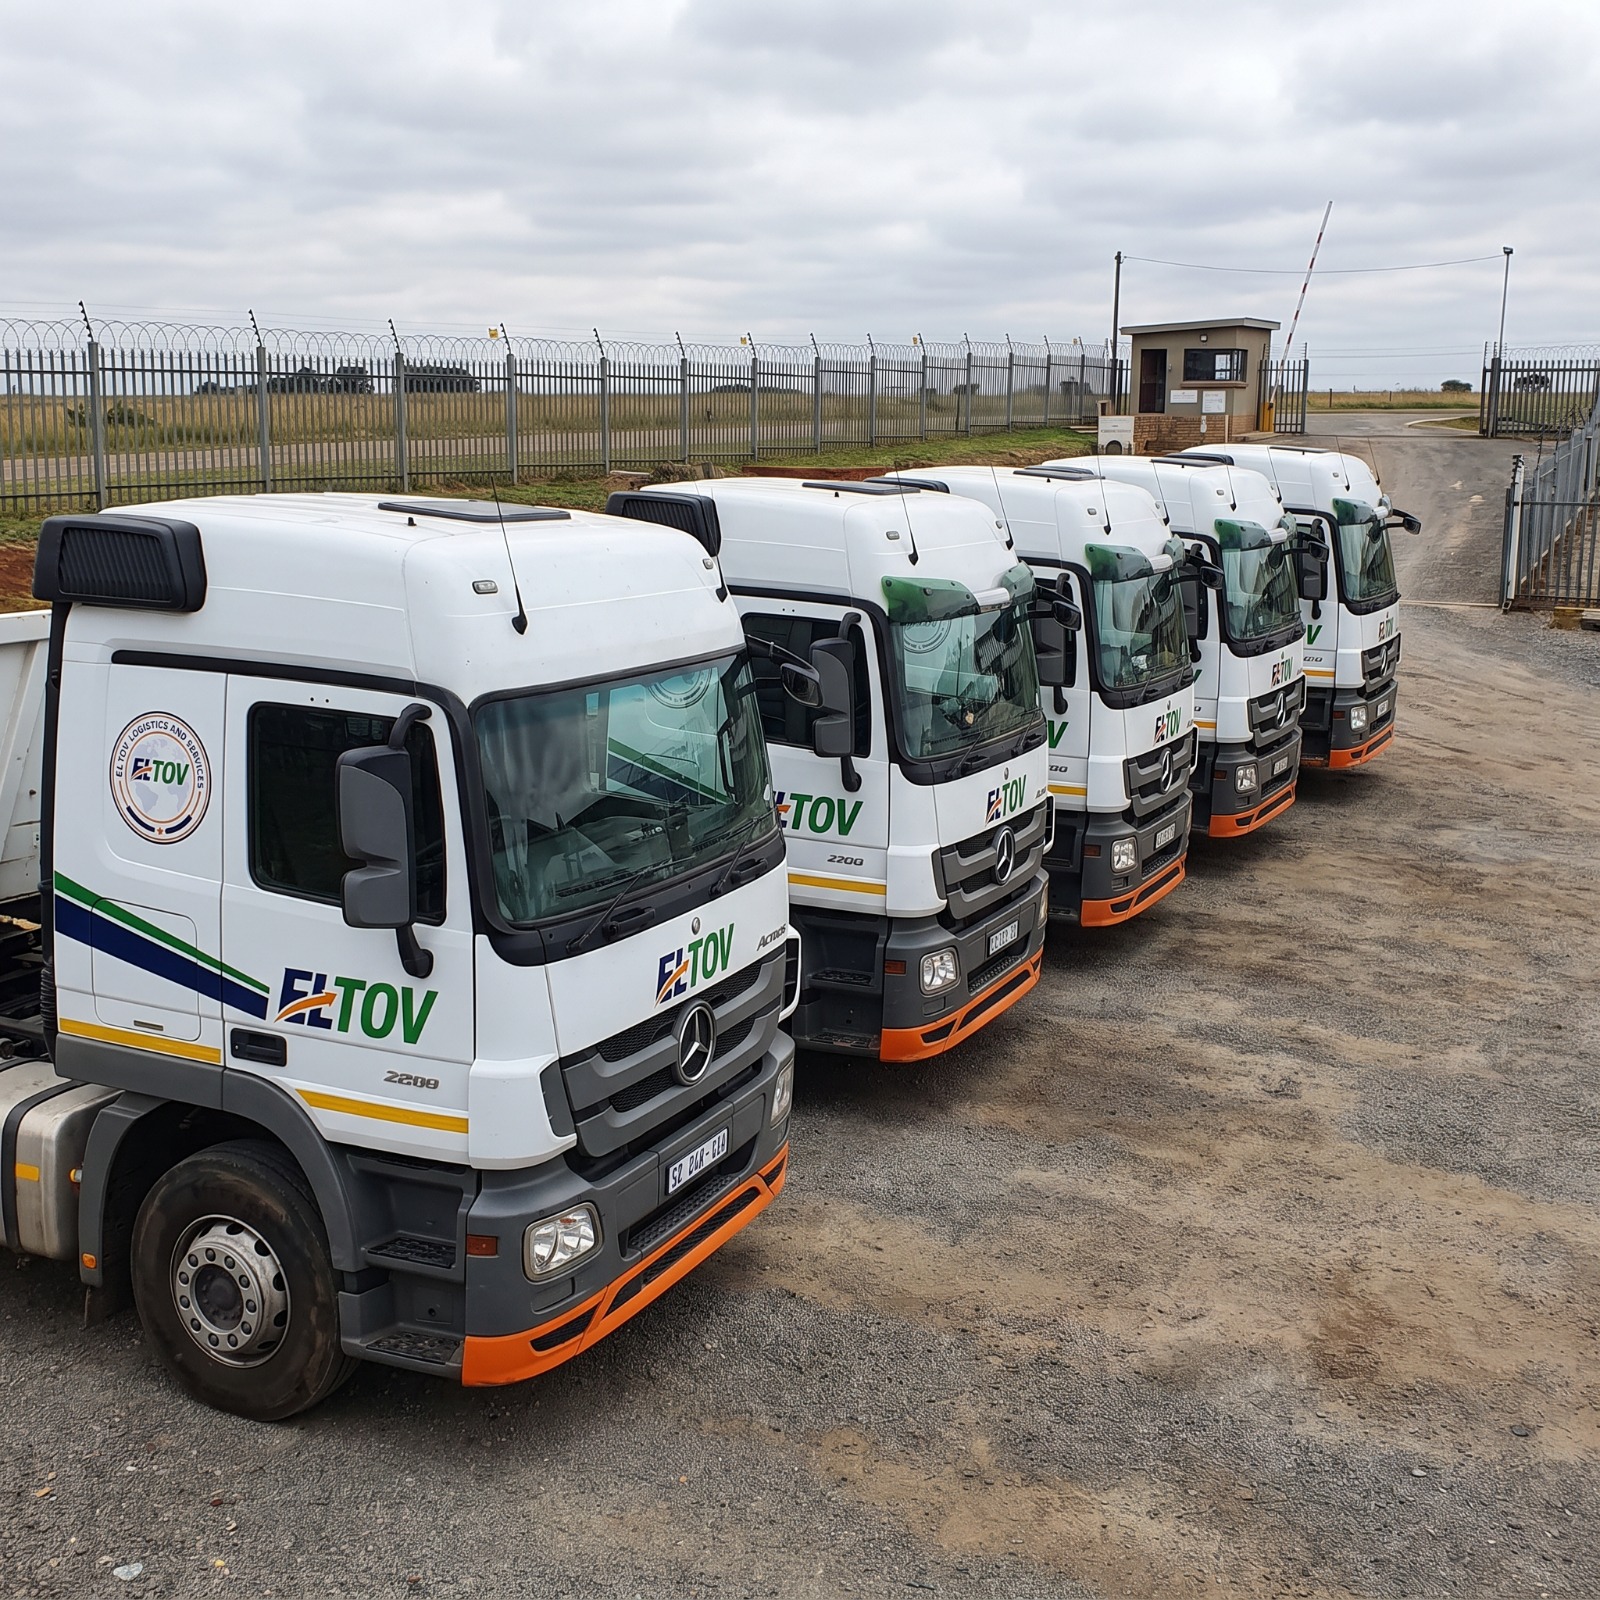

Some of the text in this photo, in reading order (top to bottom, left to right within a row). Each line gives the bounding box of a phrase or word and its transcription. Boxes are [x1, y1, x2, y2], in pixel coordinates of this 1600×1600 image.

[128, 720, 169, 742] LOGISTICS
[169, 725, 187, 741] AND
[131, 757, 190, 786] ELTOV
[986, 774, 1027, 824] ELTOV
[655, 923, 735, 1005] ELTOV
[276, 967, 439, 1045] ELTOV
